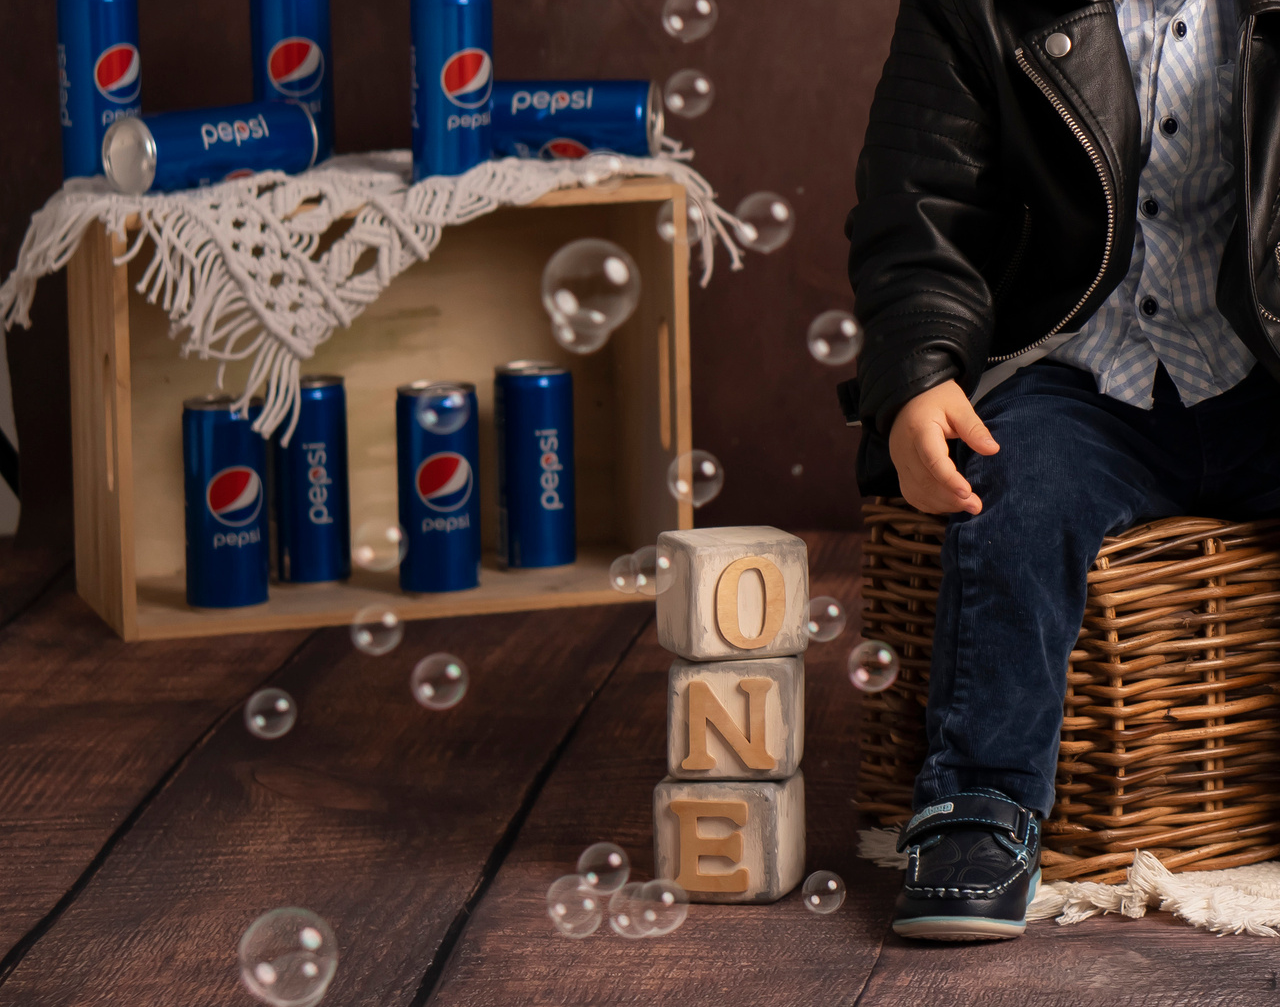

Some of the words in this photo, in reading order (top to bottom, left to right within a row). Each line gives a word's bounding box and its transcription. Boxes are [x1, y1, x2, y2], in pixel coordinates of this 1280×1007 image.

[511, 87, 594, 116] pepsi
[200, 113, 270, 151] pepsi
[447, 111, 492, 132] pepsi
[301, 441, 333, 525] pepsi
[534, 428, 564, 510] pepsi
[421, 512, 471, 534] pepsi
[213, 527, 261, 549] pepsi
